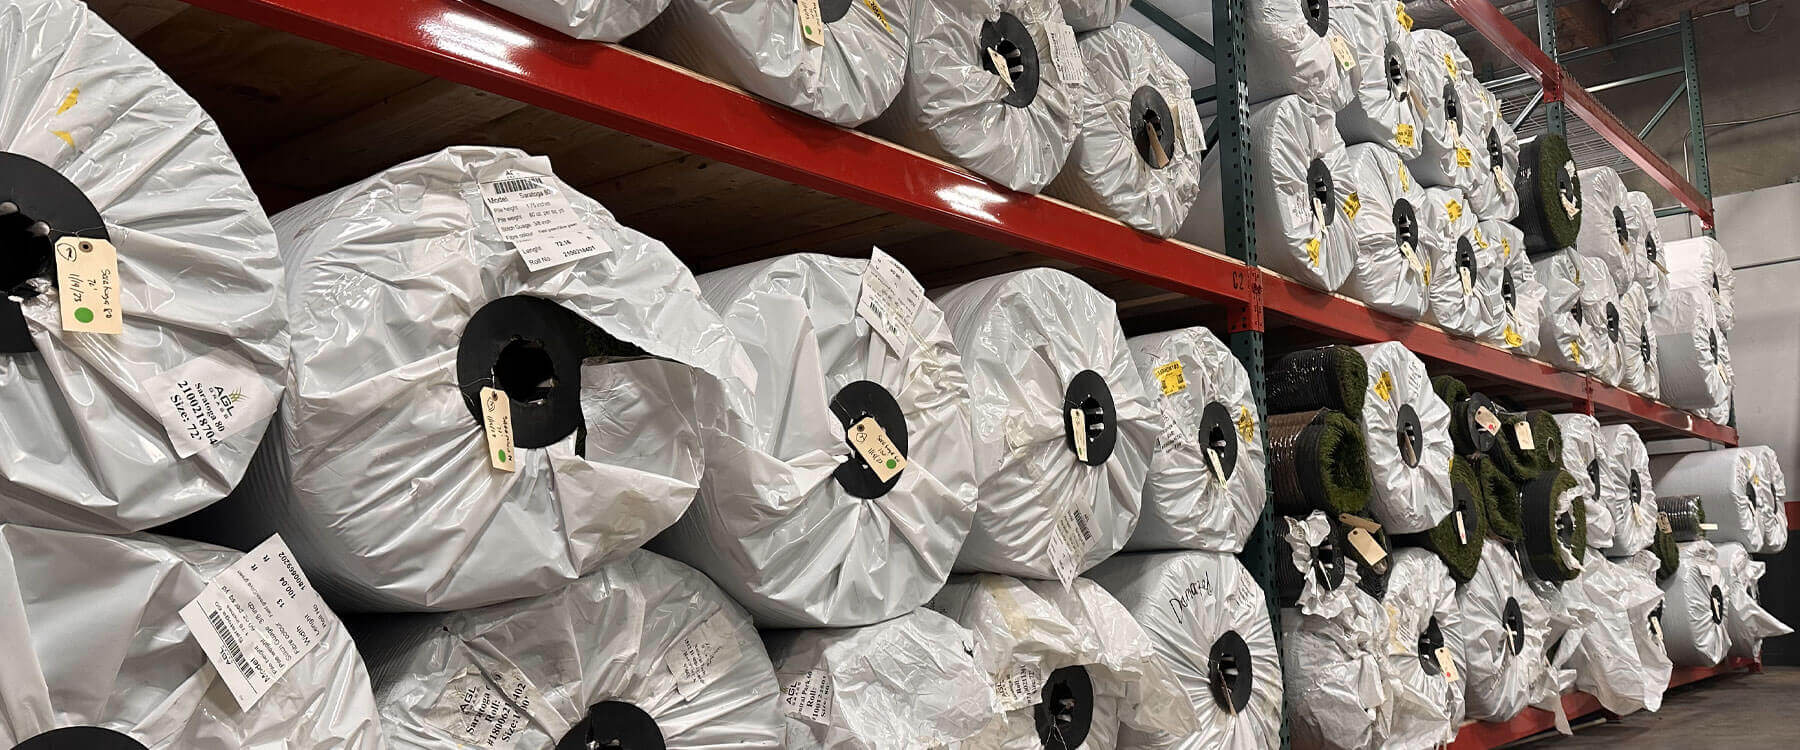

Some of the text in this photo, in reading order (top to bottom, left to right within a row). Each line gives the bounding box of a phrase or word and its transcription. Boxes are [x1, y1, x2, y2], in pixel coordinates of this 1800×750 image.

[170, 394, 189, 422] Size:
[195, 383, 225, 432] Saratoga 80
[214, 386, 234, 416] AGL
[178, 381, 217, 445] 2100218704
[279, 577, 296, 599] 100.04
[247, 601, 258, 614] inch
[276, 598, 285, 608] 13
[275, 622, 290, 639] colour
[296, 625, 310, 646] Width
[254, 645, 269, 662] height
[260, 638, 276, 656] weight
[288, 639, 300, 654] Fibre
[250, 657, 270, 682] Model
[268, 662, 277, 674] Pile
[786, 680, 797, 704] AGL
[801, 680, 810, 694] Park
[806, 687, 816, 707] Roll:
[460, 686, 477, 712] AGL
[466, 693, 490, 734] Saratoga
[484, 700, 500, 723] Roll:
